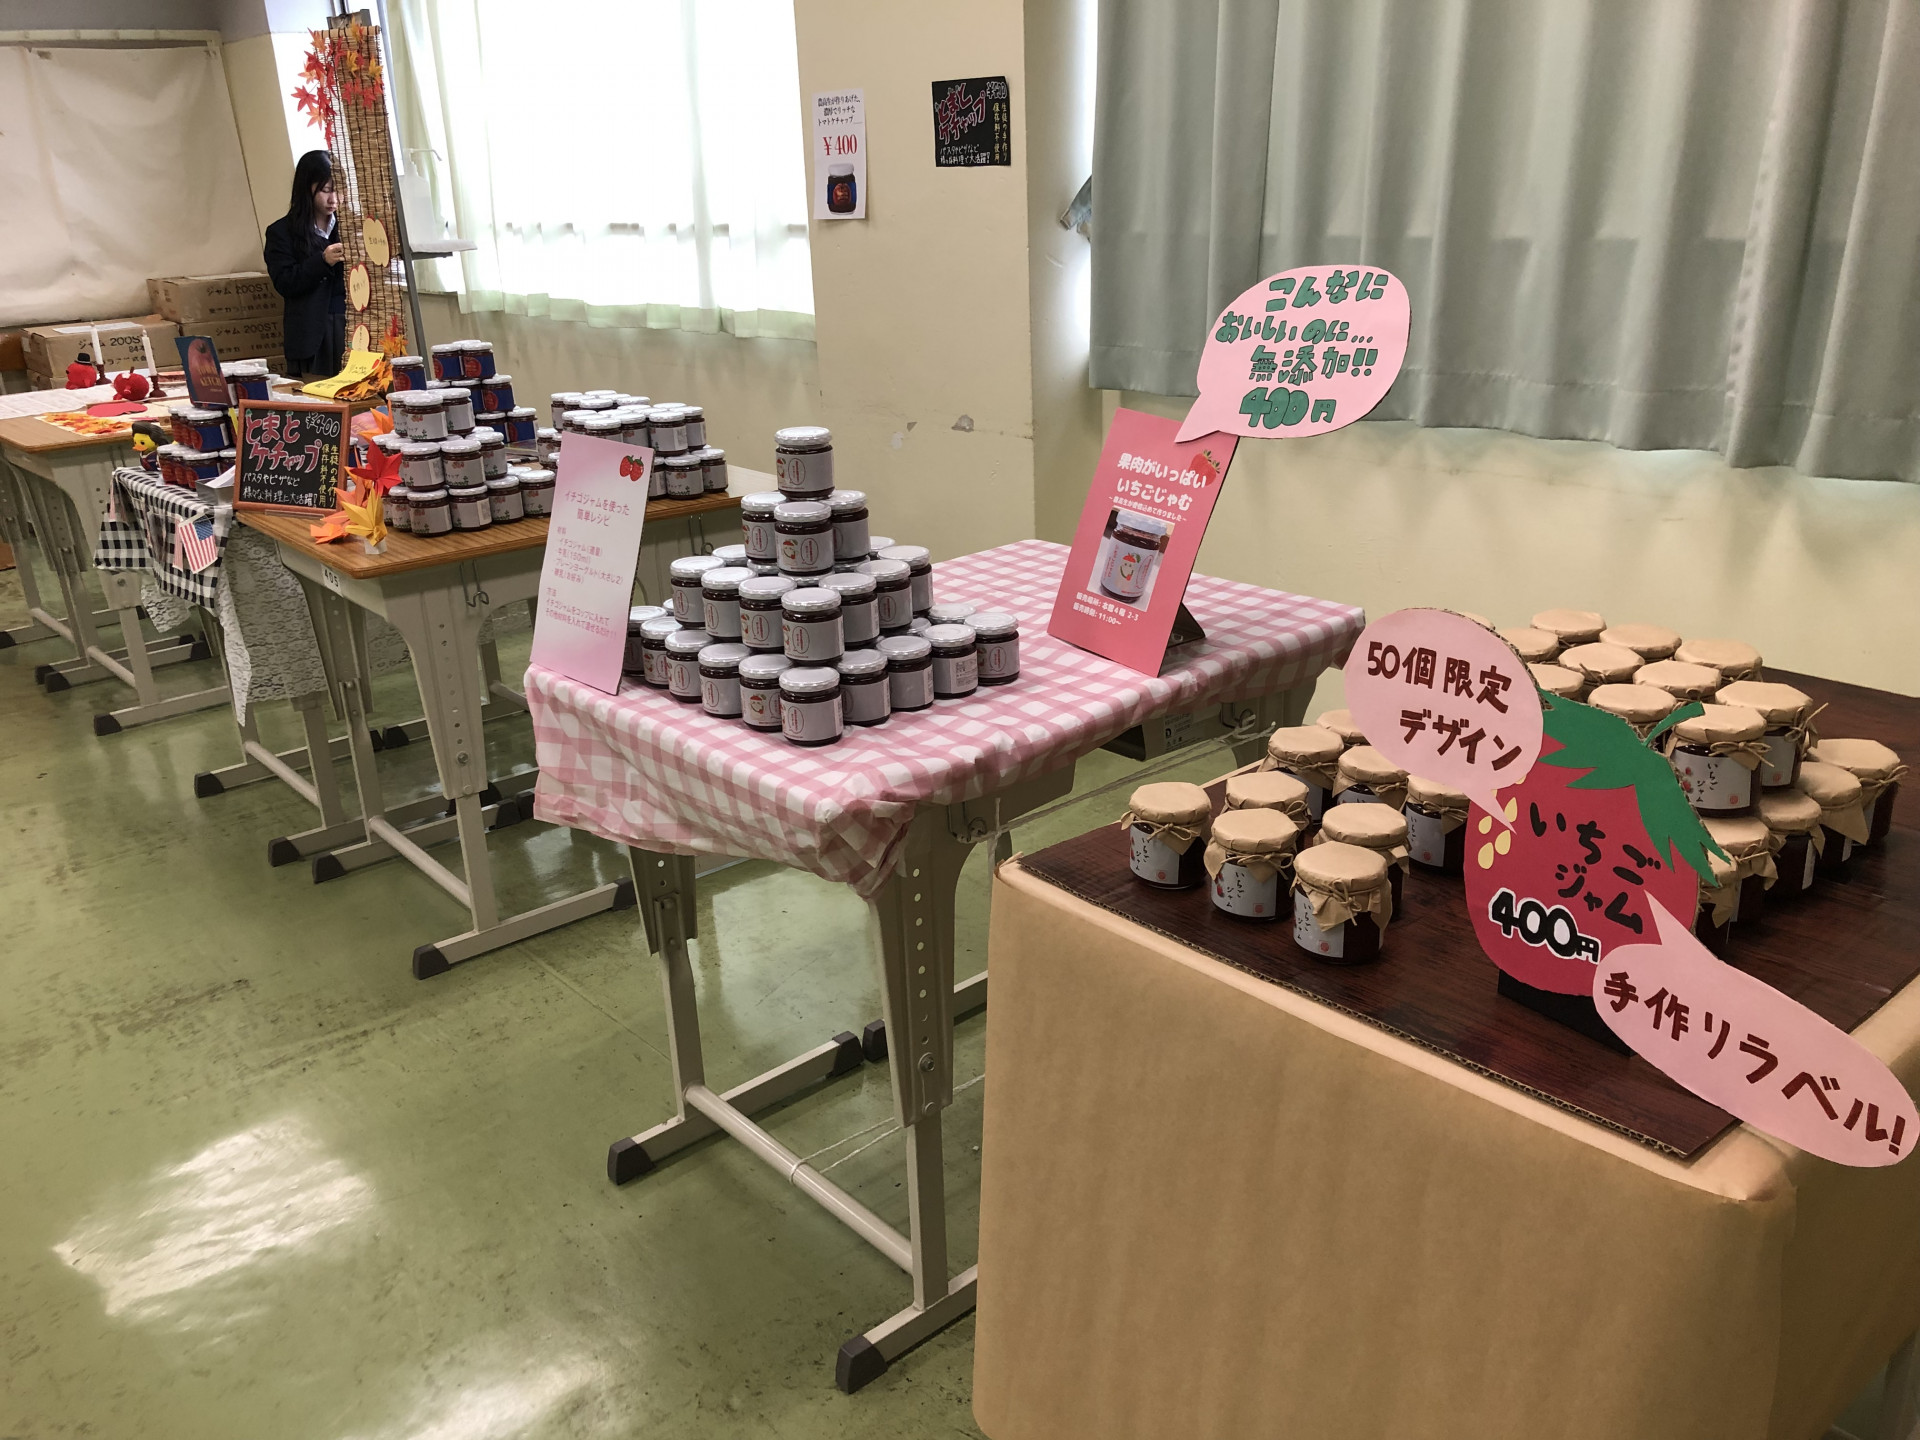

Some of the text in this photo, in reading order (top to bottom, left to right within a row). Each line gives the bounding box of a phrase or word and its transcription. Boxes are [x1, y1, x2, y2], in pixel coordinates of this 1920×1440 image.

[939, 90, 986, 144] ケチャップ
[1266, 270, 1389, 312] こんなに
[1249, 345, 1378, 386] 無添加!!
[245, 413, 301, 444] とまと
[305, 411, 341, 437] ¥400
[1239, 387, 1337, 430] 400円
[248, 439, 322, 473] ケチャップ
[319, 444, 330, 508] 保存料不使用
[328, 445, 339, 508] 生徒の手作り
[1117, 452, 1207, 489] 果肉がいっぱい
[243, 473, 301, 487] パスタやピザなど
[1117, 477, 1193, 512] いちごじゃむ
[565, 490, 630, 516] イチゴジャムを使った
[577, 508, 611, 527] 簡単レシピ
[1367, 641, 1512, 715] 50個限定
[1399, 708, 1523, 771] デザイン
[1529, 801, 1662, 886] いちご
[1555, 863, 1644, 935] ジャム
[1489, 888, 1601, 965] 400円
